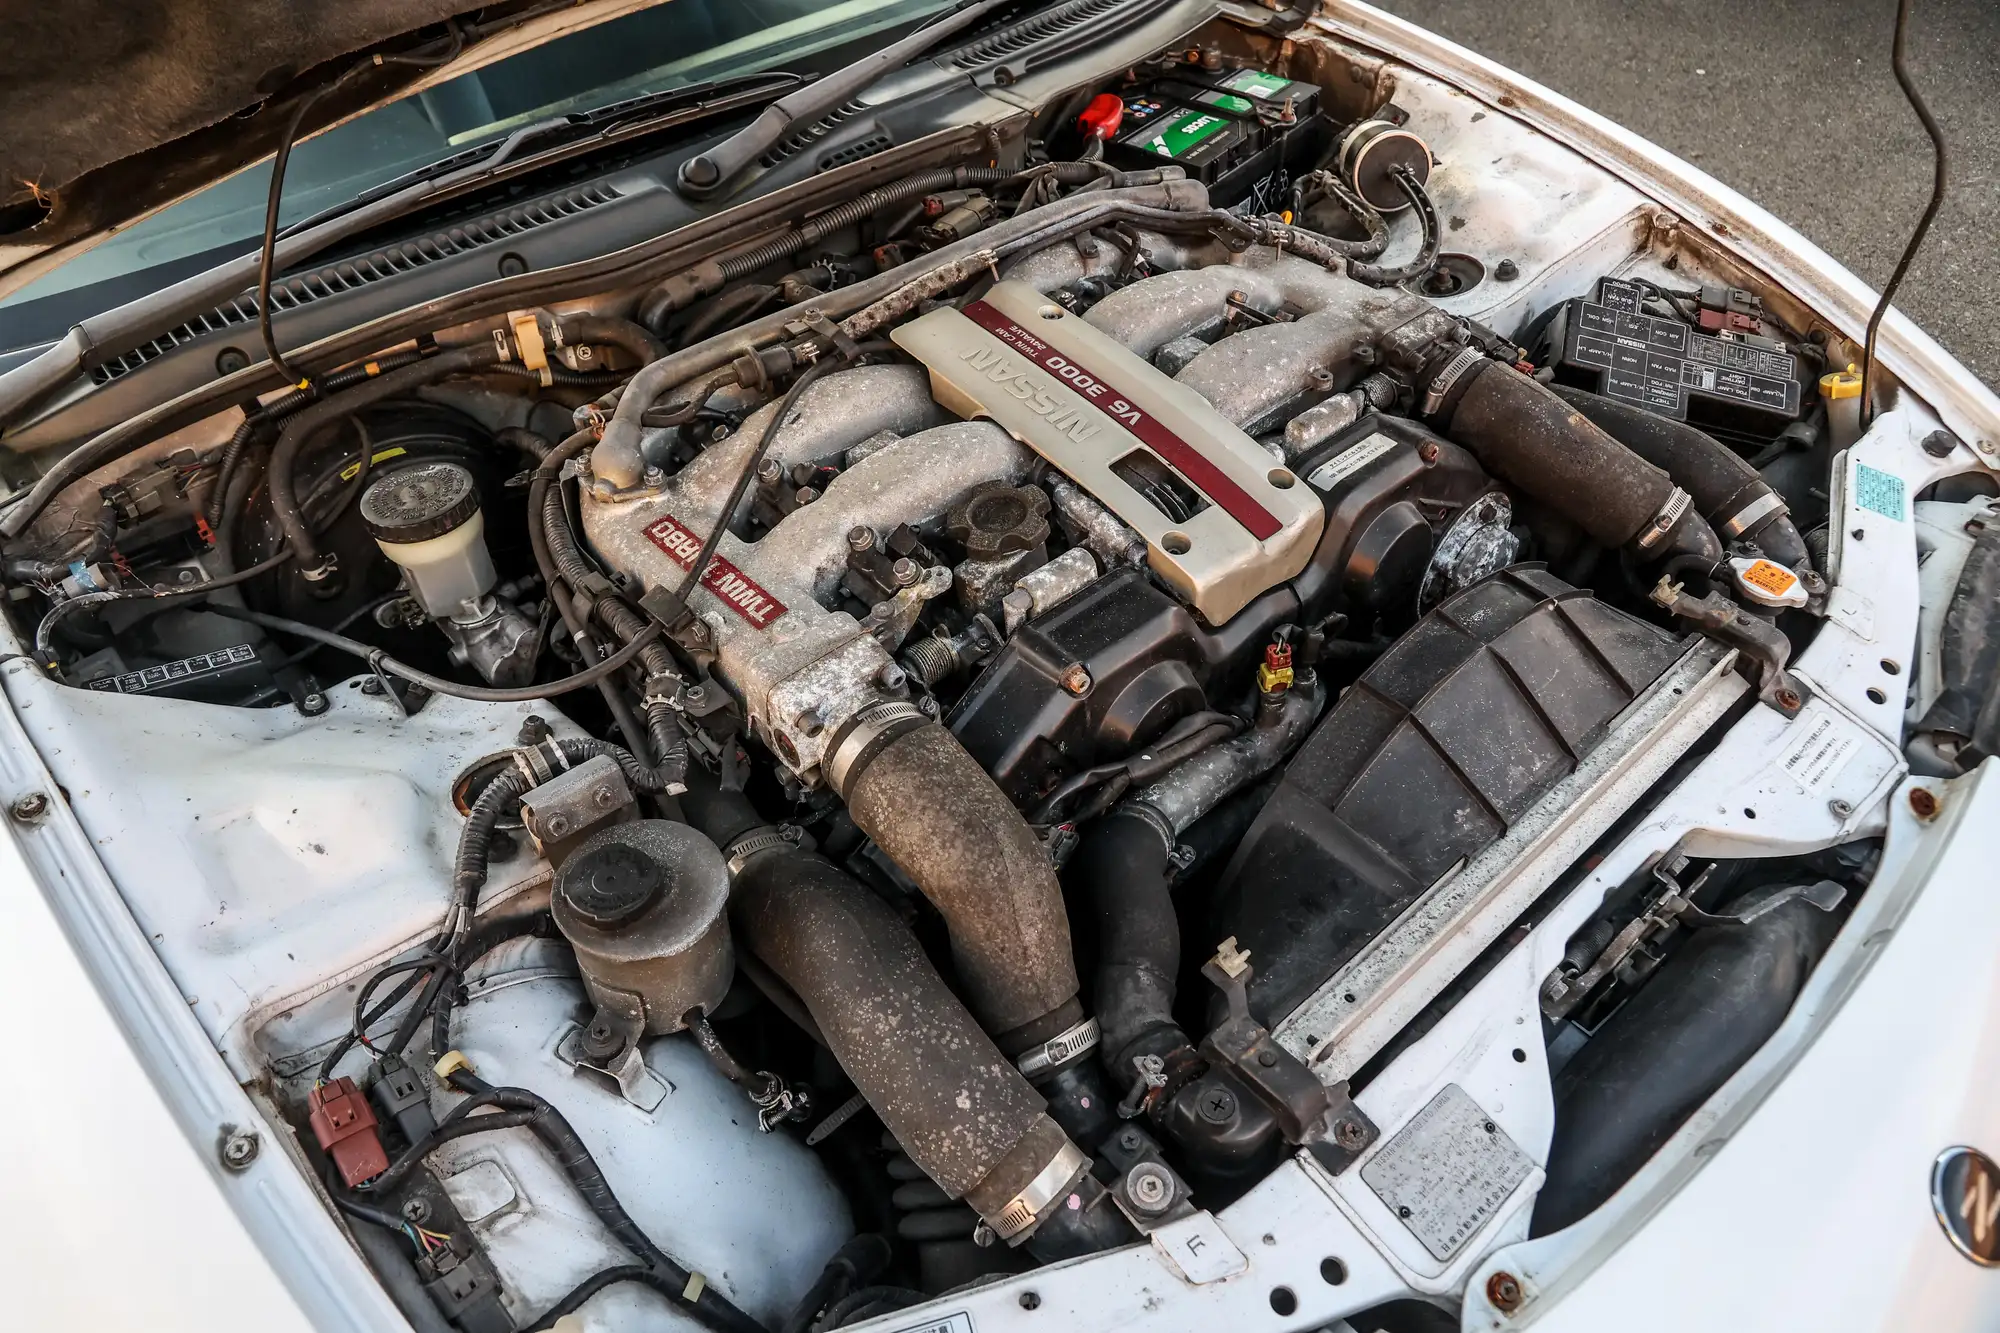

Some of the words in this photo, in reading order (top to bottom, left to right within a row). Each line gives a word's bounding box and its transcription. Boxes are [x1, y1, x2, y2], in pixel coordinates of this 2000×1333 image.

[1585, 312, 1600, 320] COIL
[994, 326, 1016, 341] CAM
[1008, 324, 1046, 349] 24VALVE
[1014, 339, 1039, 357] TWIN
[1616, 336, 1646, 349] NISSAN
[1587, 347, 1611, 357] H/LAMP
[1620, 355, 1637, 363] HORN
[1044, 354, 1107, 397] 3000
[1664, 365, 1677, 373] RAD
[1719, 374, 1746, 385] DAYTIME
[959, 340, 1102, 444] NISSAN
[1716, 384, 1734, 392] LAMP
[1734, 388, 1748, 396] FOG
[1650, 396, 1670, 405] THEFT
[1107, 397, 1141, 426] V6
[713, 571, 774, 623] TWIN
[1373, 1146, 1397, 1169] NISSAN
